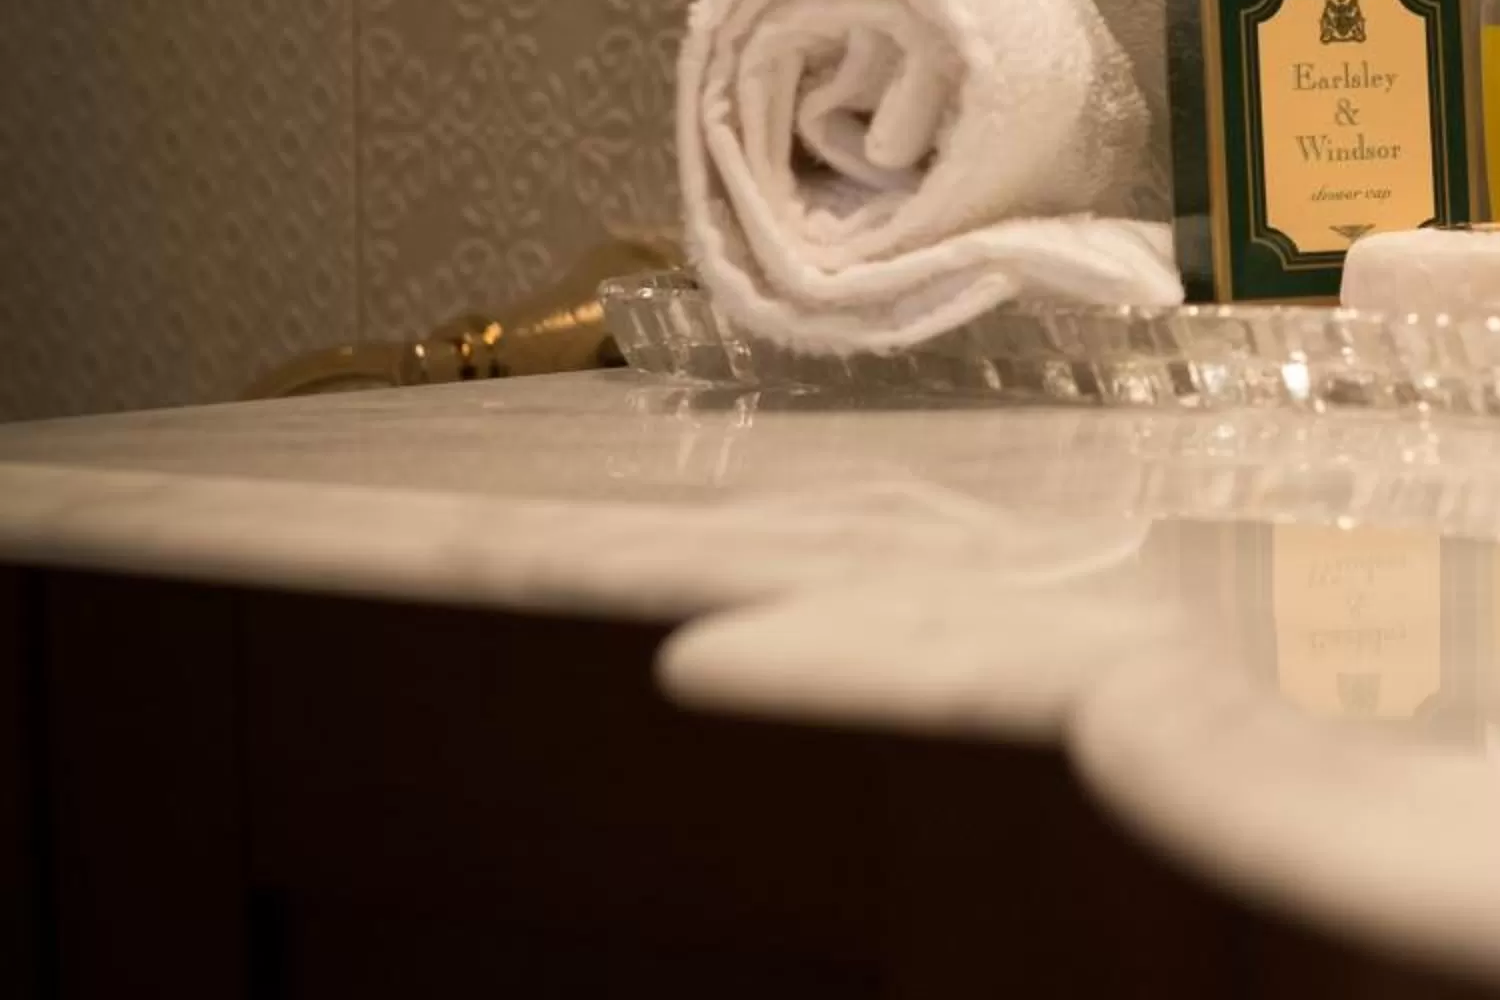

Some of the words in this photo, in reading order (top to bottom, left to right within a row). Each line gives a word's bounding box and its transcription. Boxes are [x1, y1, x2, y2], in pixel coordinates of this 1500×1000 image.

[1292, 60, 1399, 93] Earlsley
[1334, 97, 1359, 126] &
[1295, 133, 1402, 162] Windsor
